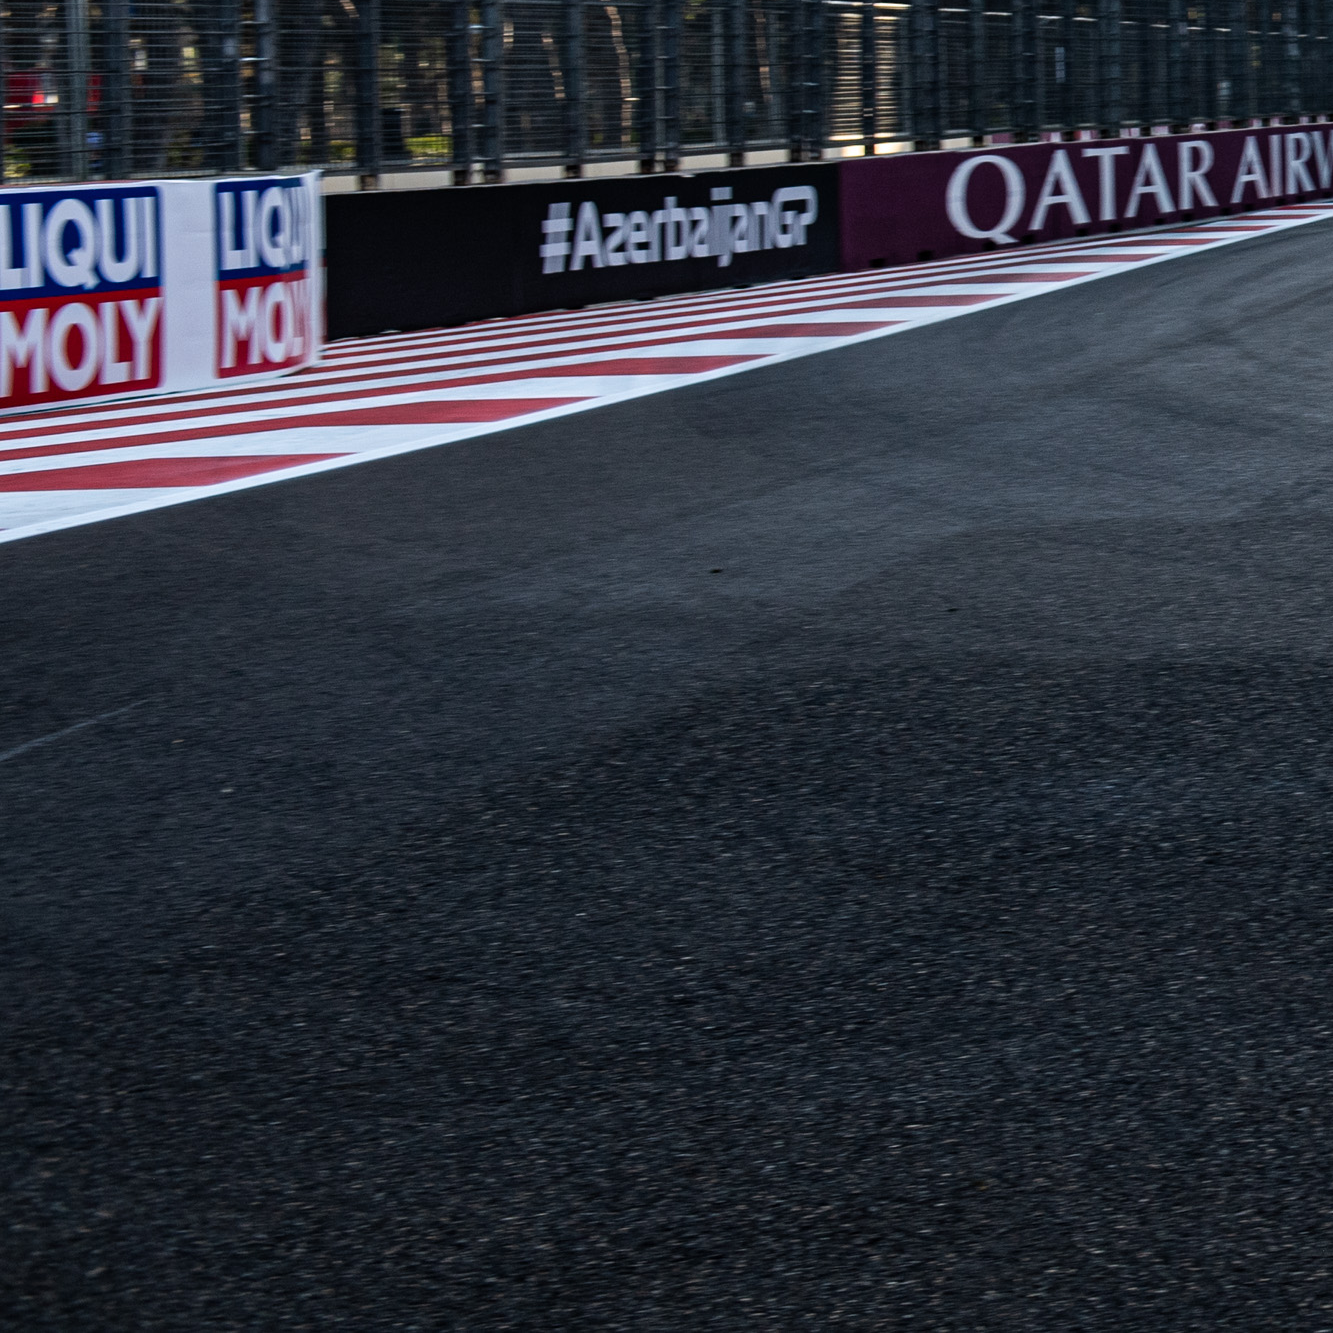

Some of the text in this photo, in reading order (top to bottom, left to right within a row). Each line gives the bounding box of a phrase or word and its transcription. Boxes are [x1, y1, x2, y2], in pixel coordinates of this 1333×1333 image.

[945, 139, 1219, 244] QATAR
[0, 196, 157, 290] LIQUI
[0, 297, 163, 397] MOLY
